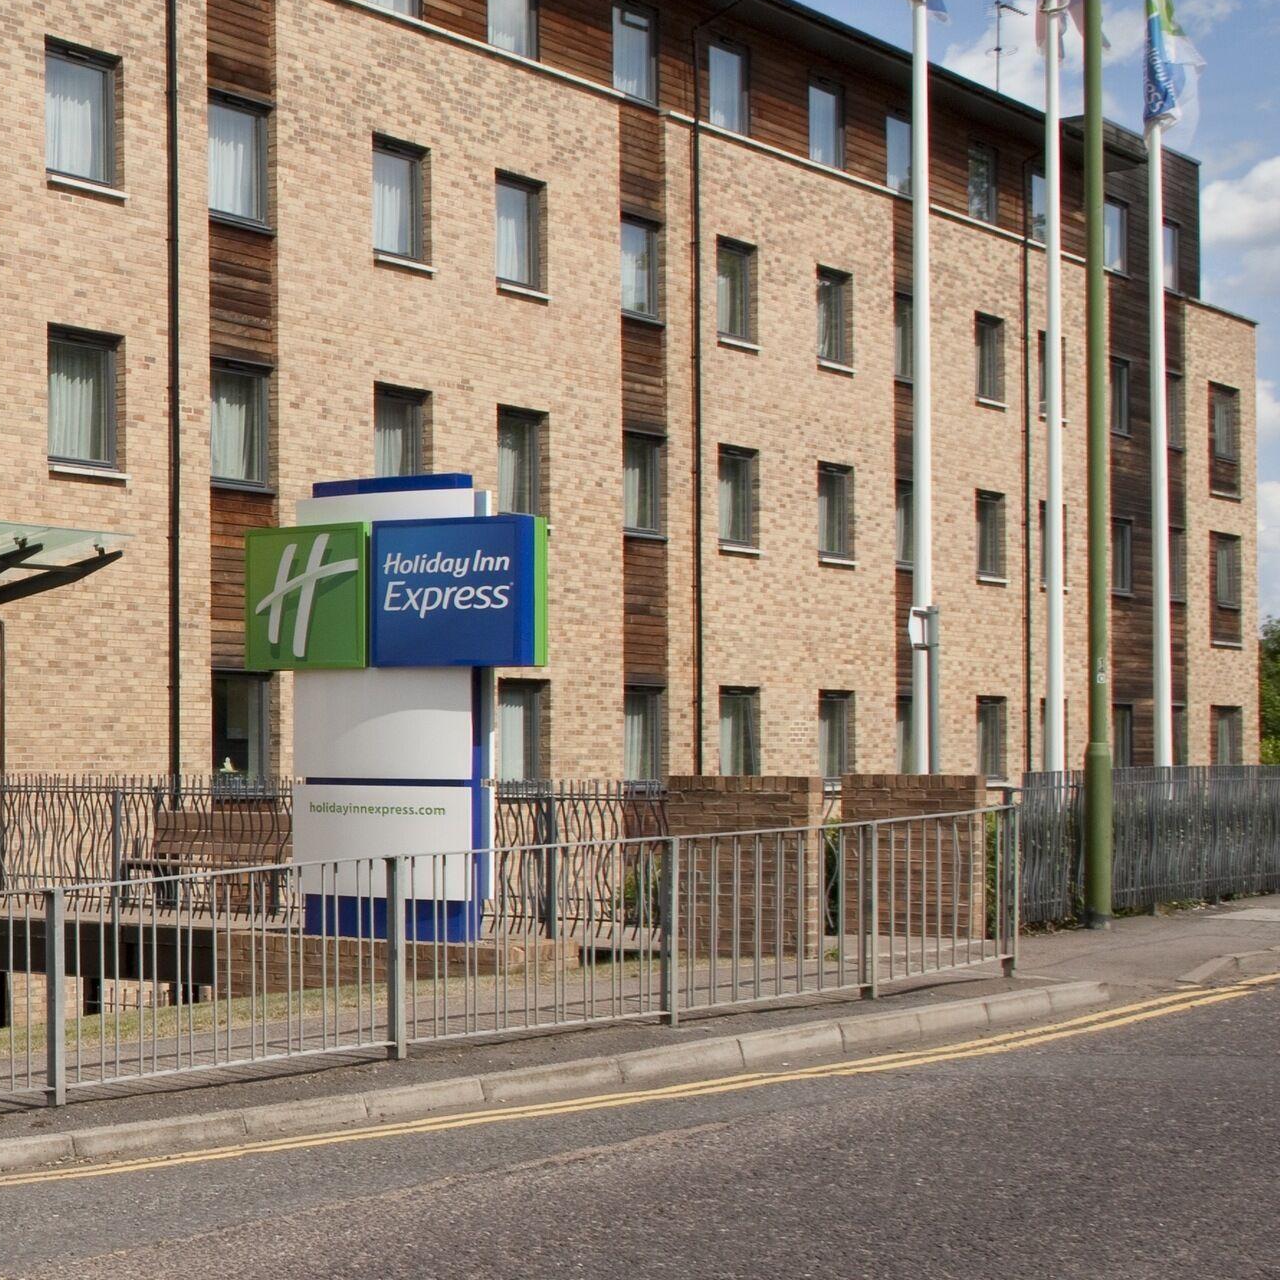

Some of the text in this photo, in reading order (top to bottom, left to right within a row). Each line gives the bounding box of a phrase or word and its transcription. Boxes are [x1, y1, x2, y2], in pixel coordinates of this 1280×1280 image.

[382, 549, 511, 578] Holiday Inn
[383, 580, 511, 619] Express
[309, 801, 446, 817] holidayinnexpress.com
